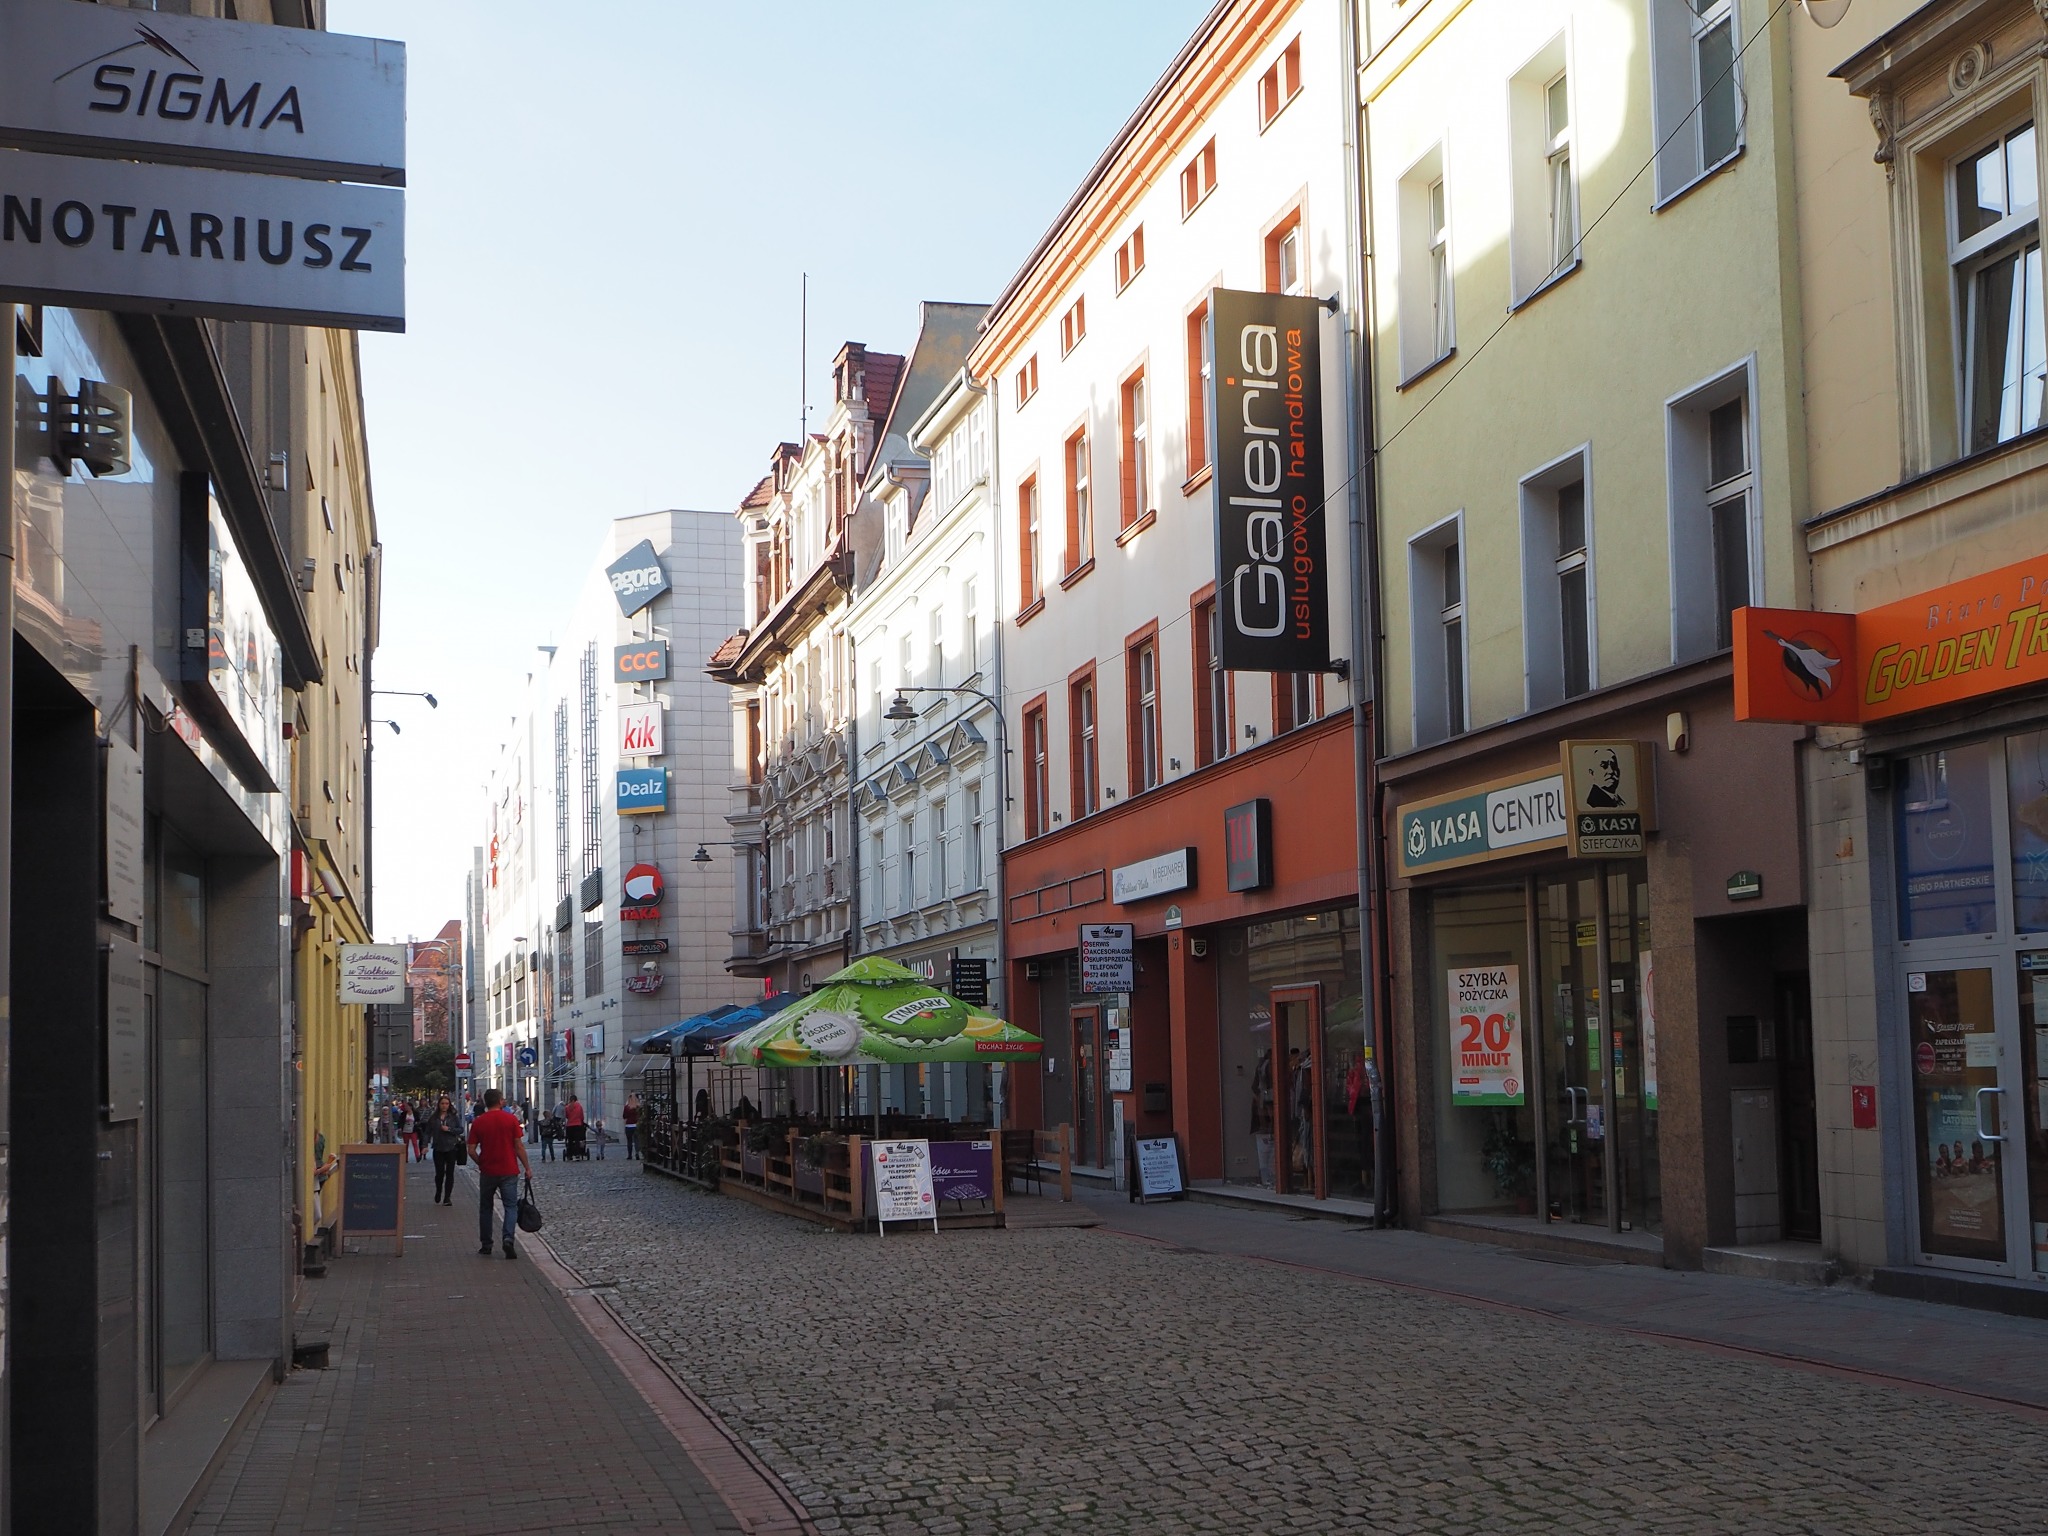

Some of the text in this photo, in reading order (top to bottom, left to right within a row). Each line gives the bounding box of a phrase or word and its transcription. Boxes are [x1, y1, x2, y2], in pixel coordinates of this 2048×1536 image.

[88, 64, 304, 134] SIGMA
[3, 194, 373, 273] NOTARIUSZ
[1285, 327, 1305, 478] handlowa
[1227, 323, 1286, 637] Galeria
[611, 566, 661, 596] agora
[1926, 593, 2001, 631] Biuro
[620, 651, 659, 672] CCC
[1865, 624, 2001, 705] GOLDEN
[619, 779, 662, 797] Dealz
[1431, 789, 1567, 848] KASA CENTRU
[1600, 817, 1637, 831] KASY
[1582, 838, 1639, 850] STEFCZYKA
[1739, 874, 1746, 885] 14
[1908, 883, 1933, 894] BIURO
[1934, 875, 1990, 890] PARTNERSKIE
[620, 907, 661, 921] ITAKA
[347, 981, 395, 995] Kawiarnia
[1459, 972, 1508, 988] SZYBKA
[1459, 988, 1508, 1001] POŻYCZKA
[887, 997, 946, 1023] TYMBARK
[814, 1029, 847, 1046] WYSOKO
[1460, 1013, 1510, 1052] 20
[977, 1043, 1003, 1051] KOCHAJ
[1462, 1053, 1511, 1067] MINUT
